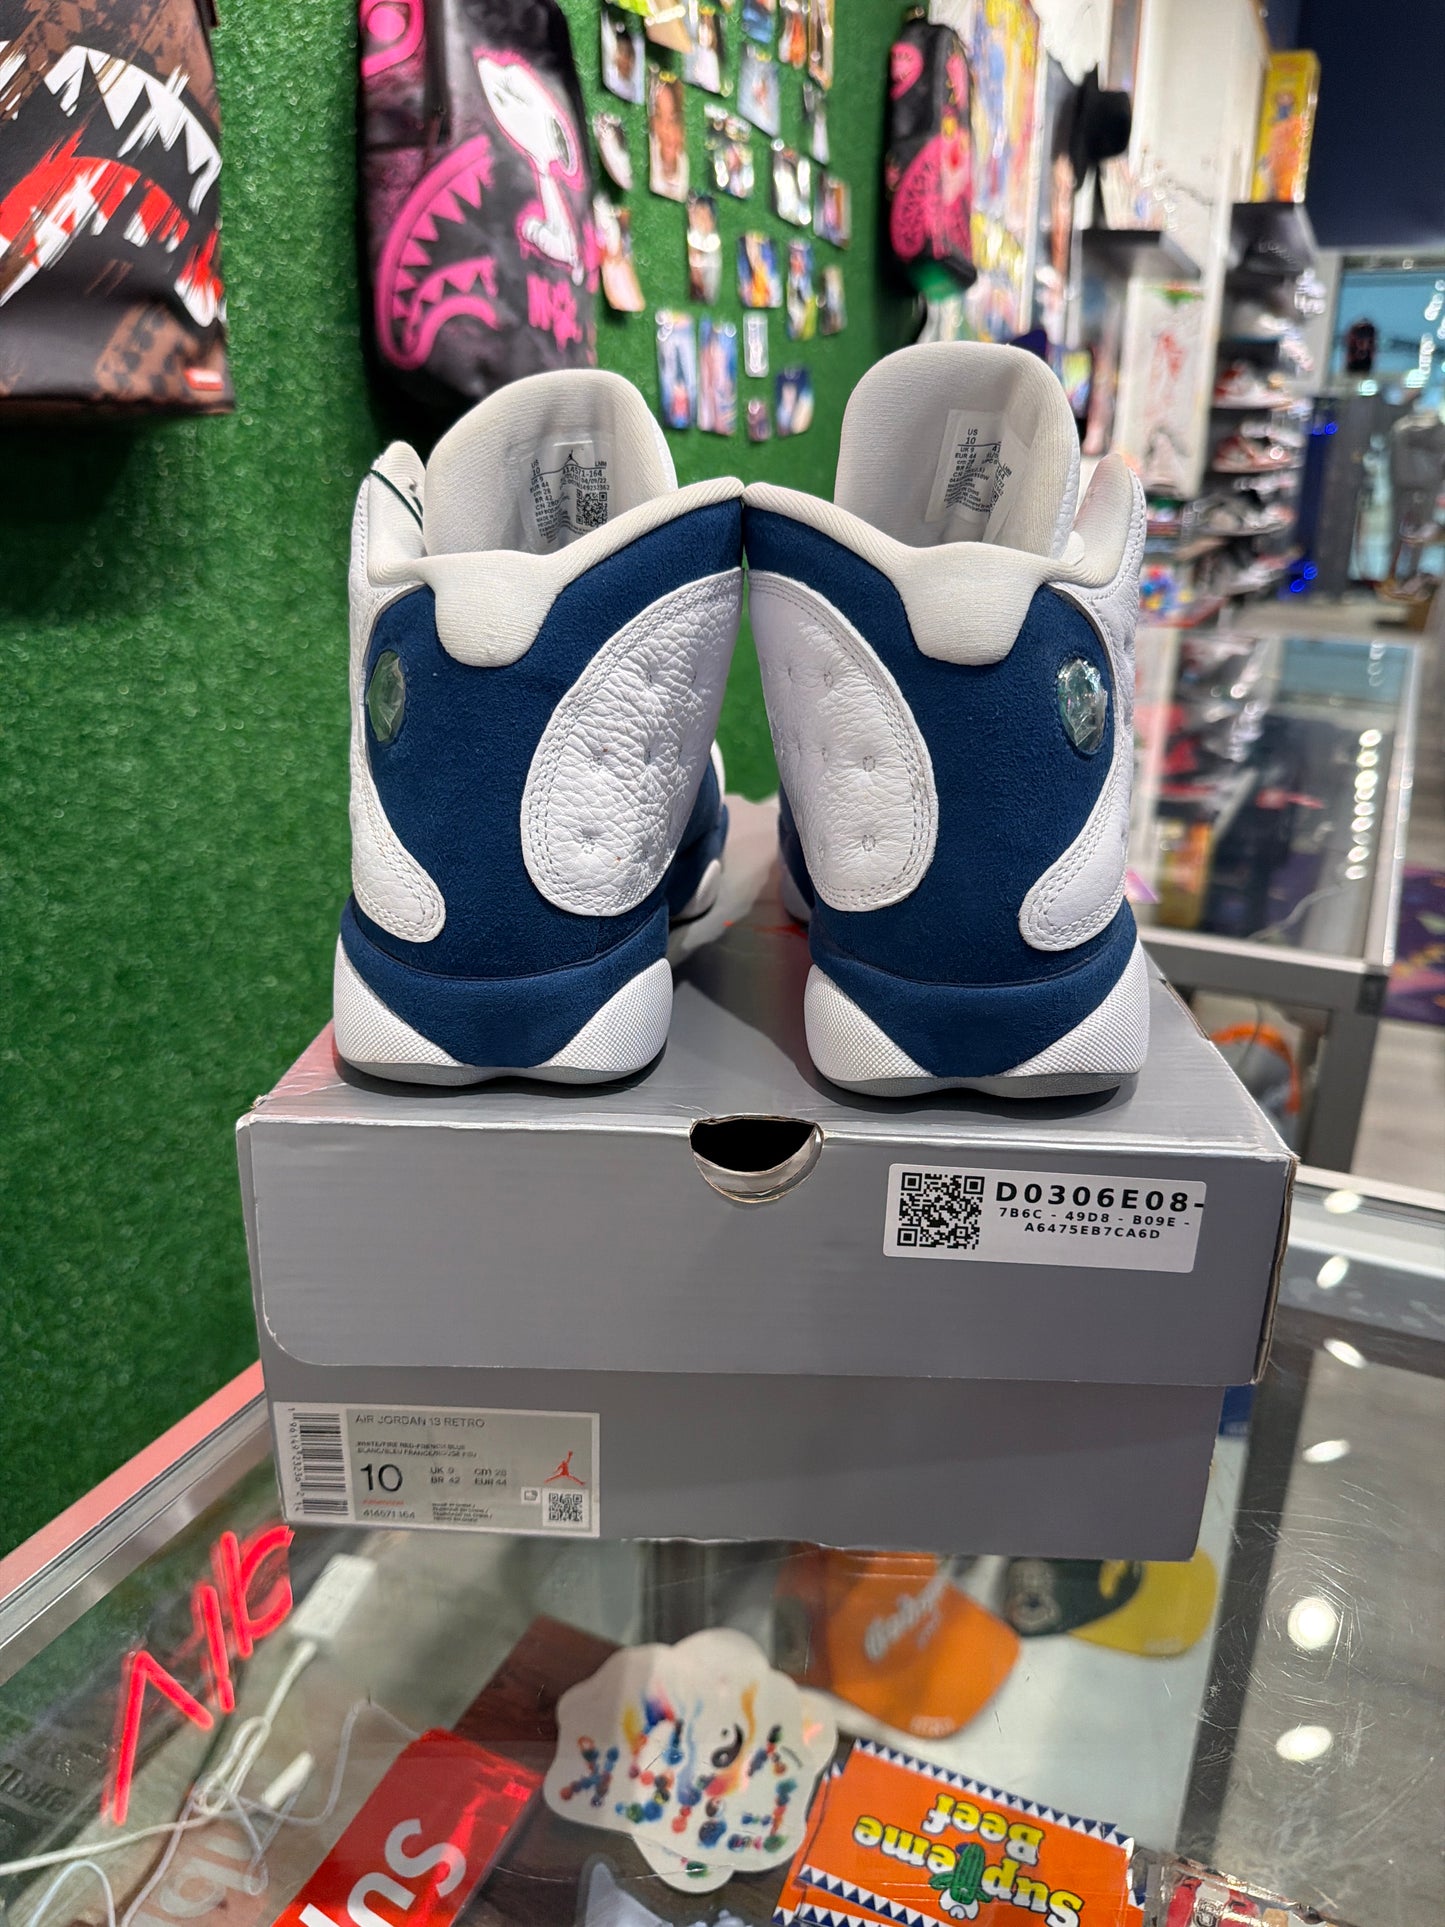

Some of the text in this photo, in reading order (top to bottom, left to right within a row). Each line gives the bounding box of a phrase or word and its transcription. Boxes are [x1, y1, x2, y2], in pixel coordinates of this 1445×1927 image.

[968, 428, 978, 436] US
[531, 460, 539, 468] US
[532, 468, 540, 476] 10
[1024, 1222, 1160, 1238] A6475EB7CA6D
[356, 1414, 485, 1428] AIR JORDAN 13 RETRO
[430, 1466, 444, 1474] UK
[474, 1468, 492, 1476] cm
[360, 1464, 403, 1492] 10
[430, 1476, 507, 1486] BR 42 EUR 44
[921, 1793, 1045, 1867] Beef
[853, 1816, 1084, 1927] Supeme
